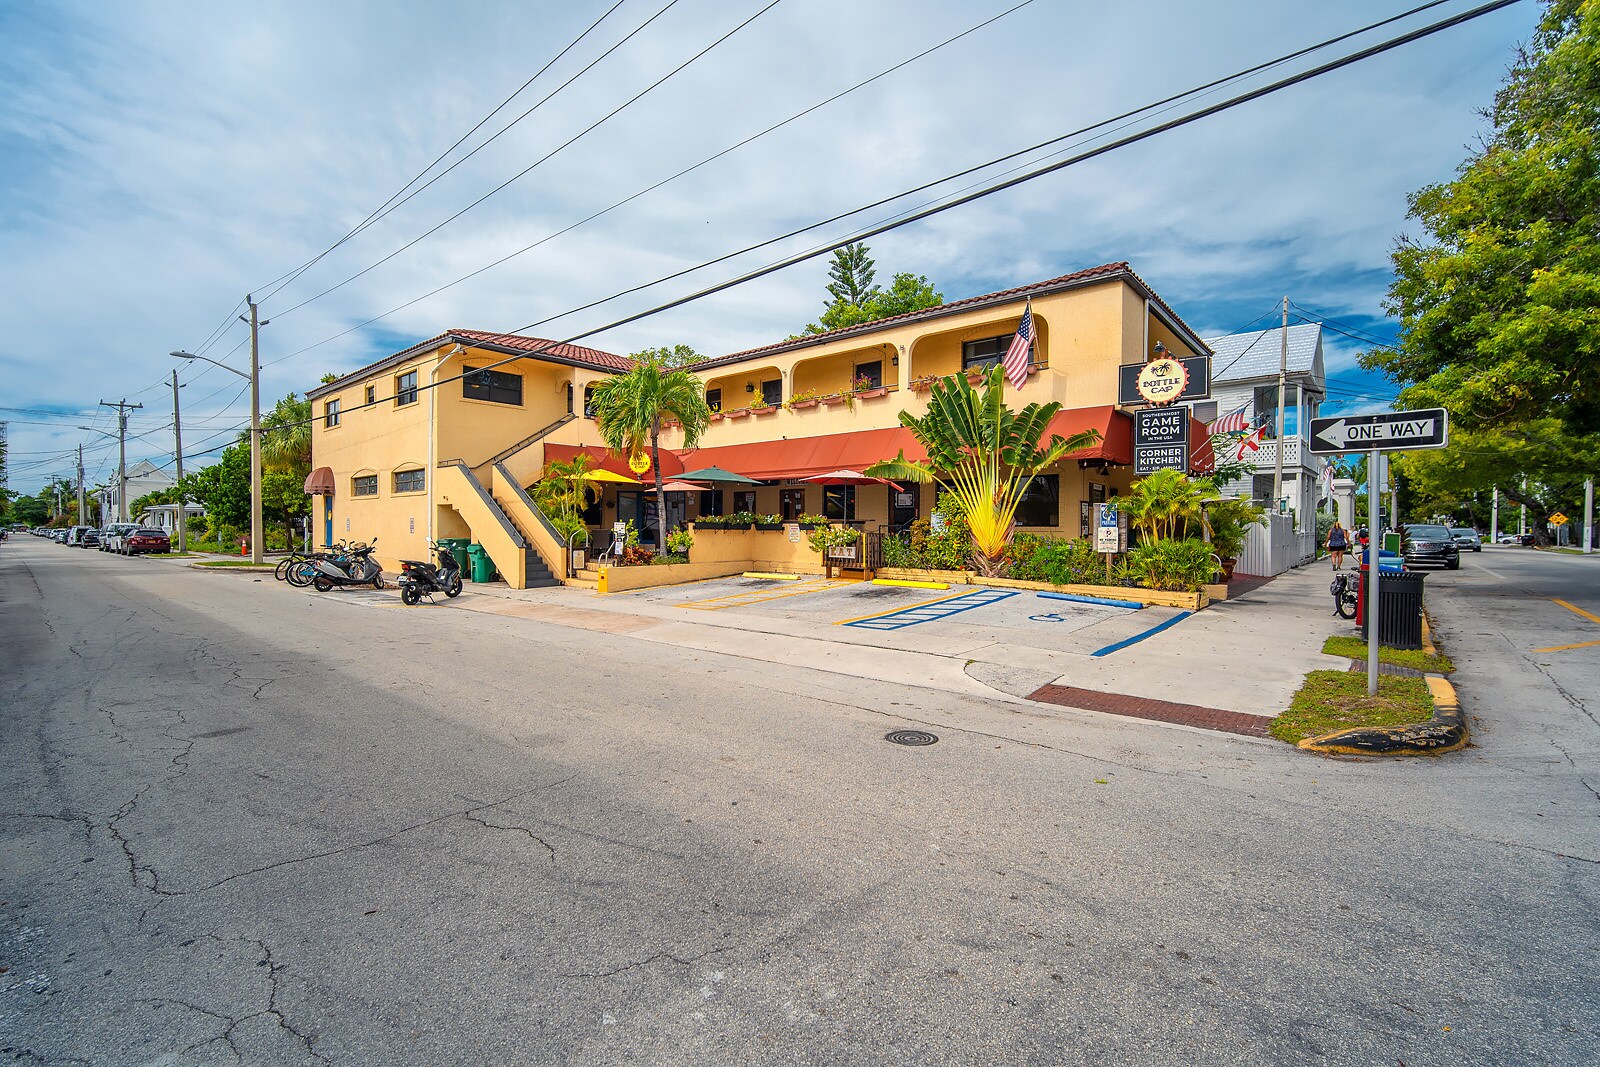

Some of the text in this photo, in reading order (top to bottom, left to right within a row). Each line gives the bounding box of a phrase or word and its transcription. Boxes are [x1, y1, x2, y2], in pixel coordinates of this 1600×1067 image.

[1143, 378, 1180, 387] BOTTLE
[1142, 416, 1180, 427] GAME
[1142, 426, 1180, 436] ROOM
[1347, 421, 1428, 439] ONE WAY
[1140, 449, 1181, 457] CORNER
[1140, 456, 1181, 465] KITCHEN
[830, 547, 853, 556] EAT
